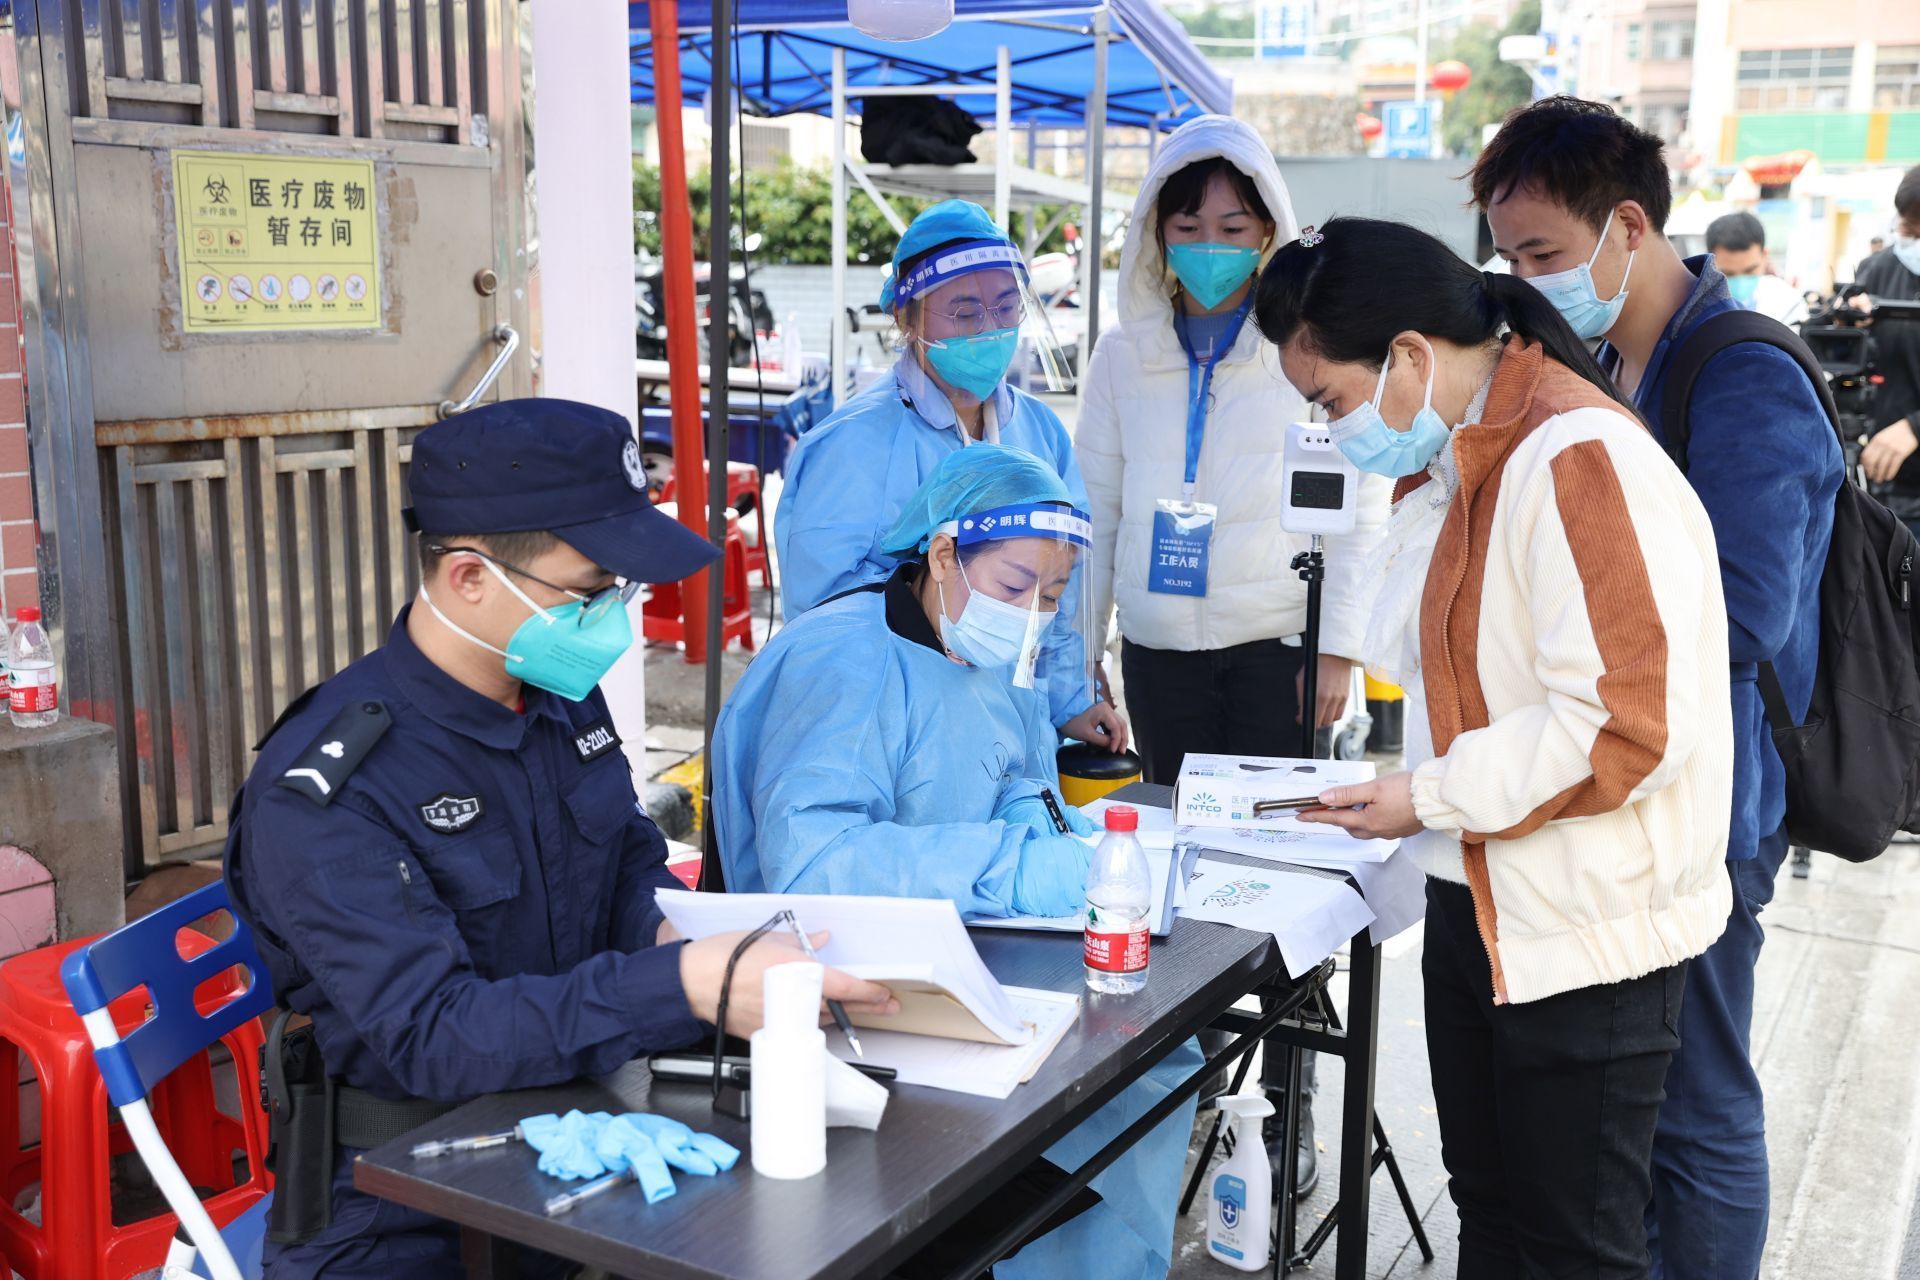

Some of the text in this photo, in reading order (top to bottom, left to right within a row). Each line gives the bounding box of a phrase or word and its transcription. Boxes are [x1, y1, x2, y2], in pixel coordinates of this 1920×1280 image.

[249, 178, 366, 210] 医疗废物
[267, 216, 352, 246] 暂存间
[916, 265, 935, 282] 明辉
[1000, 514, 1027, 527] 明辉
[1159, 554, 1198, 569] 工作人员
[1163, 578, 1192, 588] NO.3192
[577, 727, 614, 756] 02-2101
[1187, 804, 1221, 813] INTCO
